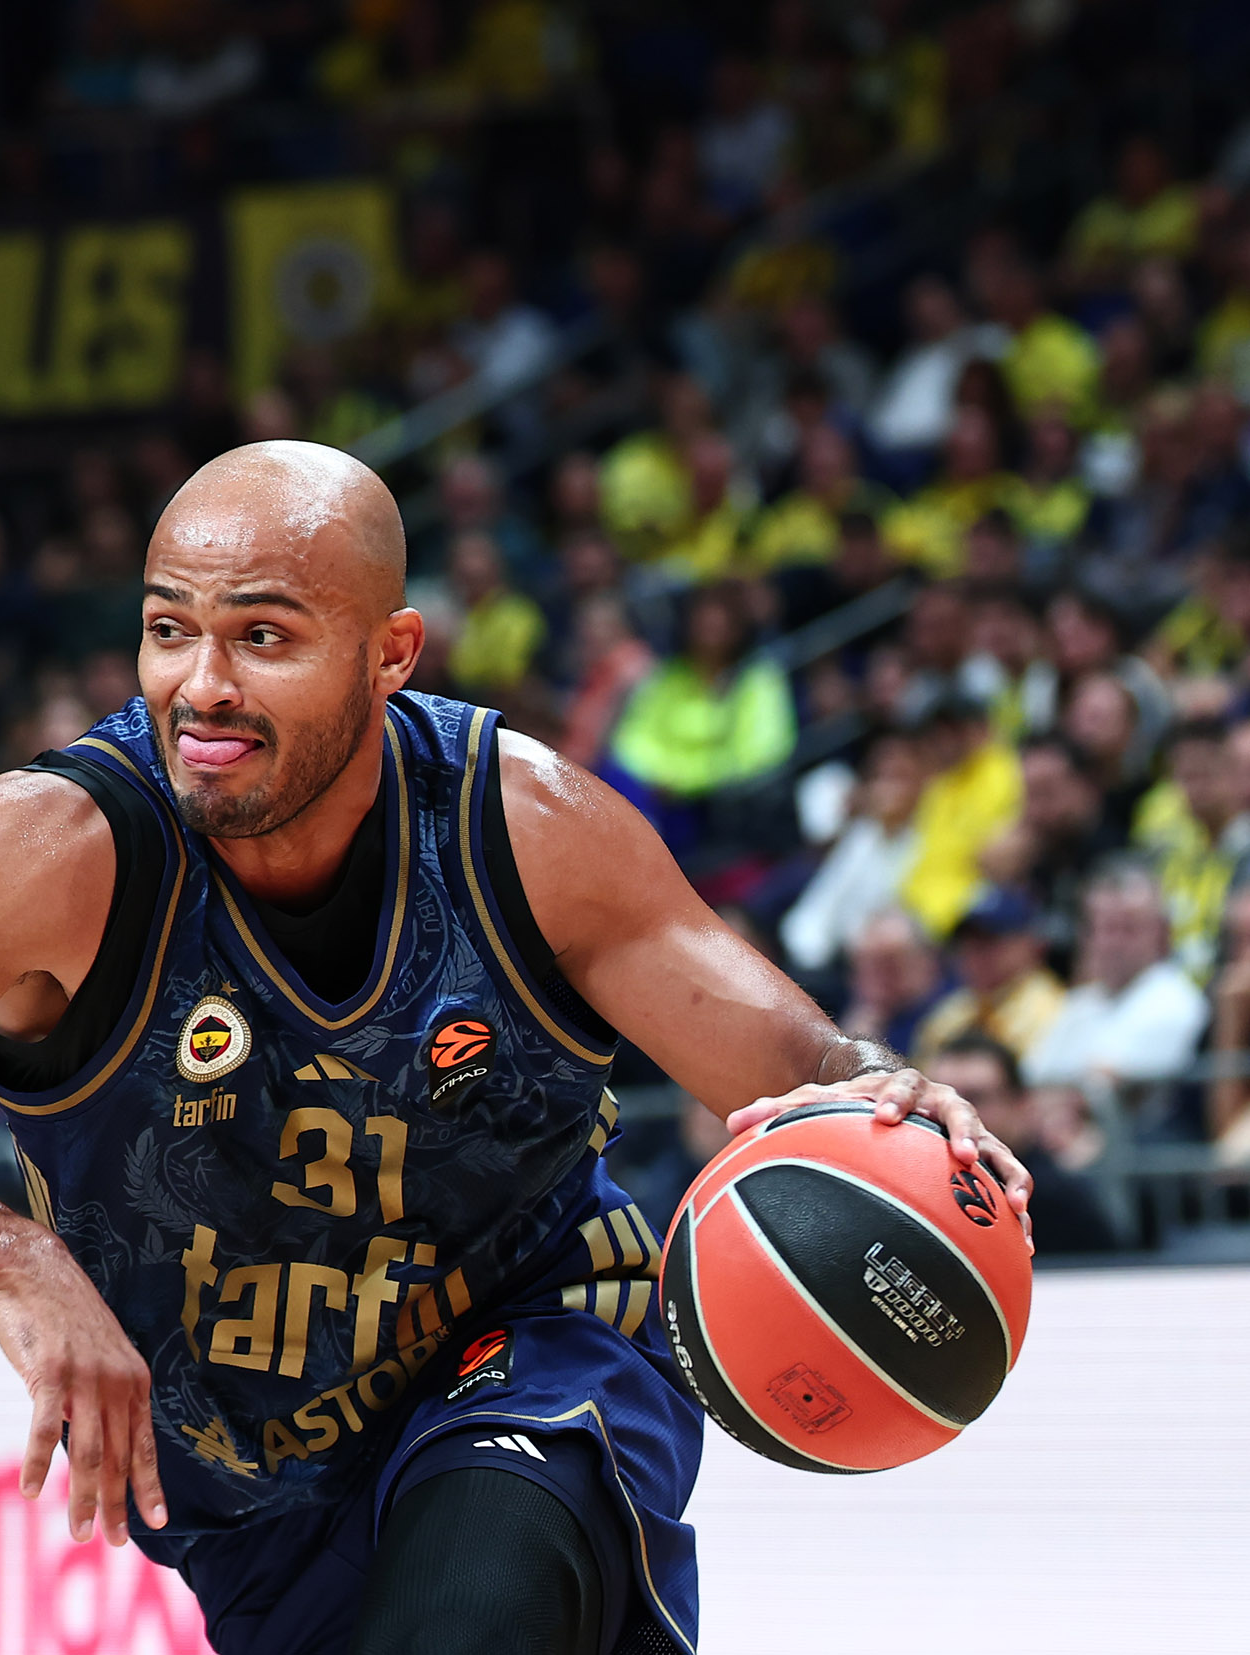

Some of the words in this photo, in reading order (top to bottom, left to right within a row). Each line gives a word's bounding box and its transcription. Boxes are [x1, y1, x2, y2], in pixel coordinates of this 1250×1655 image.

[432, 1067, 488, 1100] ETIHAD
[173, 1086, 237, 1127] tarfin
[271, 1107, 408, 1224] 31
[864, 1242, 965, 1341] LEGACY
[447, 1370, 506, 1400] ETIHAD
